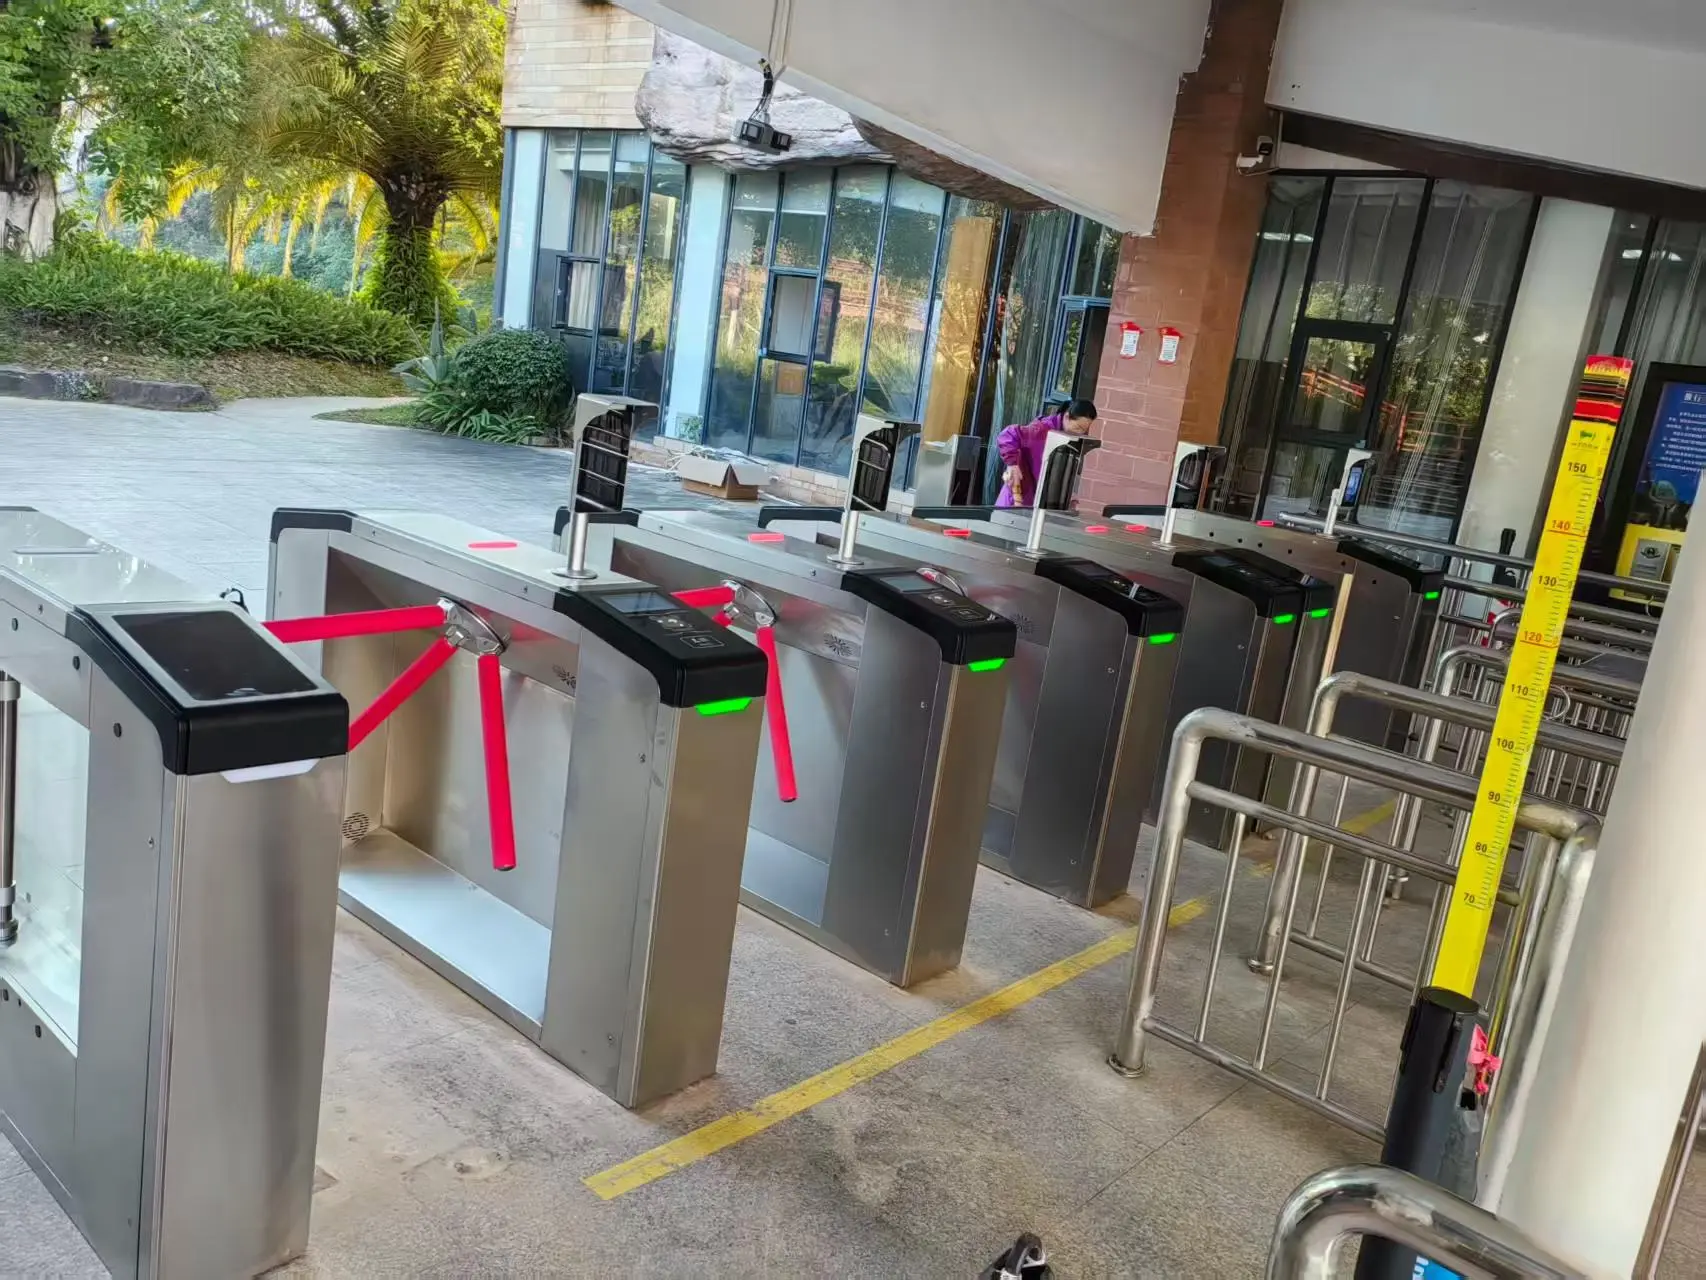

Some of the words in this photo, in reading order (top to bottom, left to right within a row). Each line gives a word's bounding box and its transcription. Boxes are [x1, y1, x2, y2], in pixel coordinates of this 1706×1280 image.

[1568, 462, 1587, 473] 150
[1552, 520, 1570, 531] 140
[1538, 575, 1557, 587] 130
[1523, 631, 1542, 642] 120
[1511, 684, 1529, 696] 110
[1496, 738, 1515, 750] 100
[1488, 791, 1501, 802] 90
[1475, 842, 1488, 853] 80
[1463, 892, 1475, 904] 70
